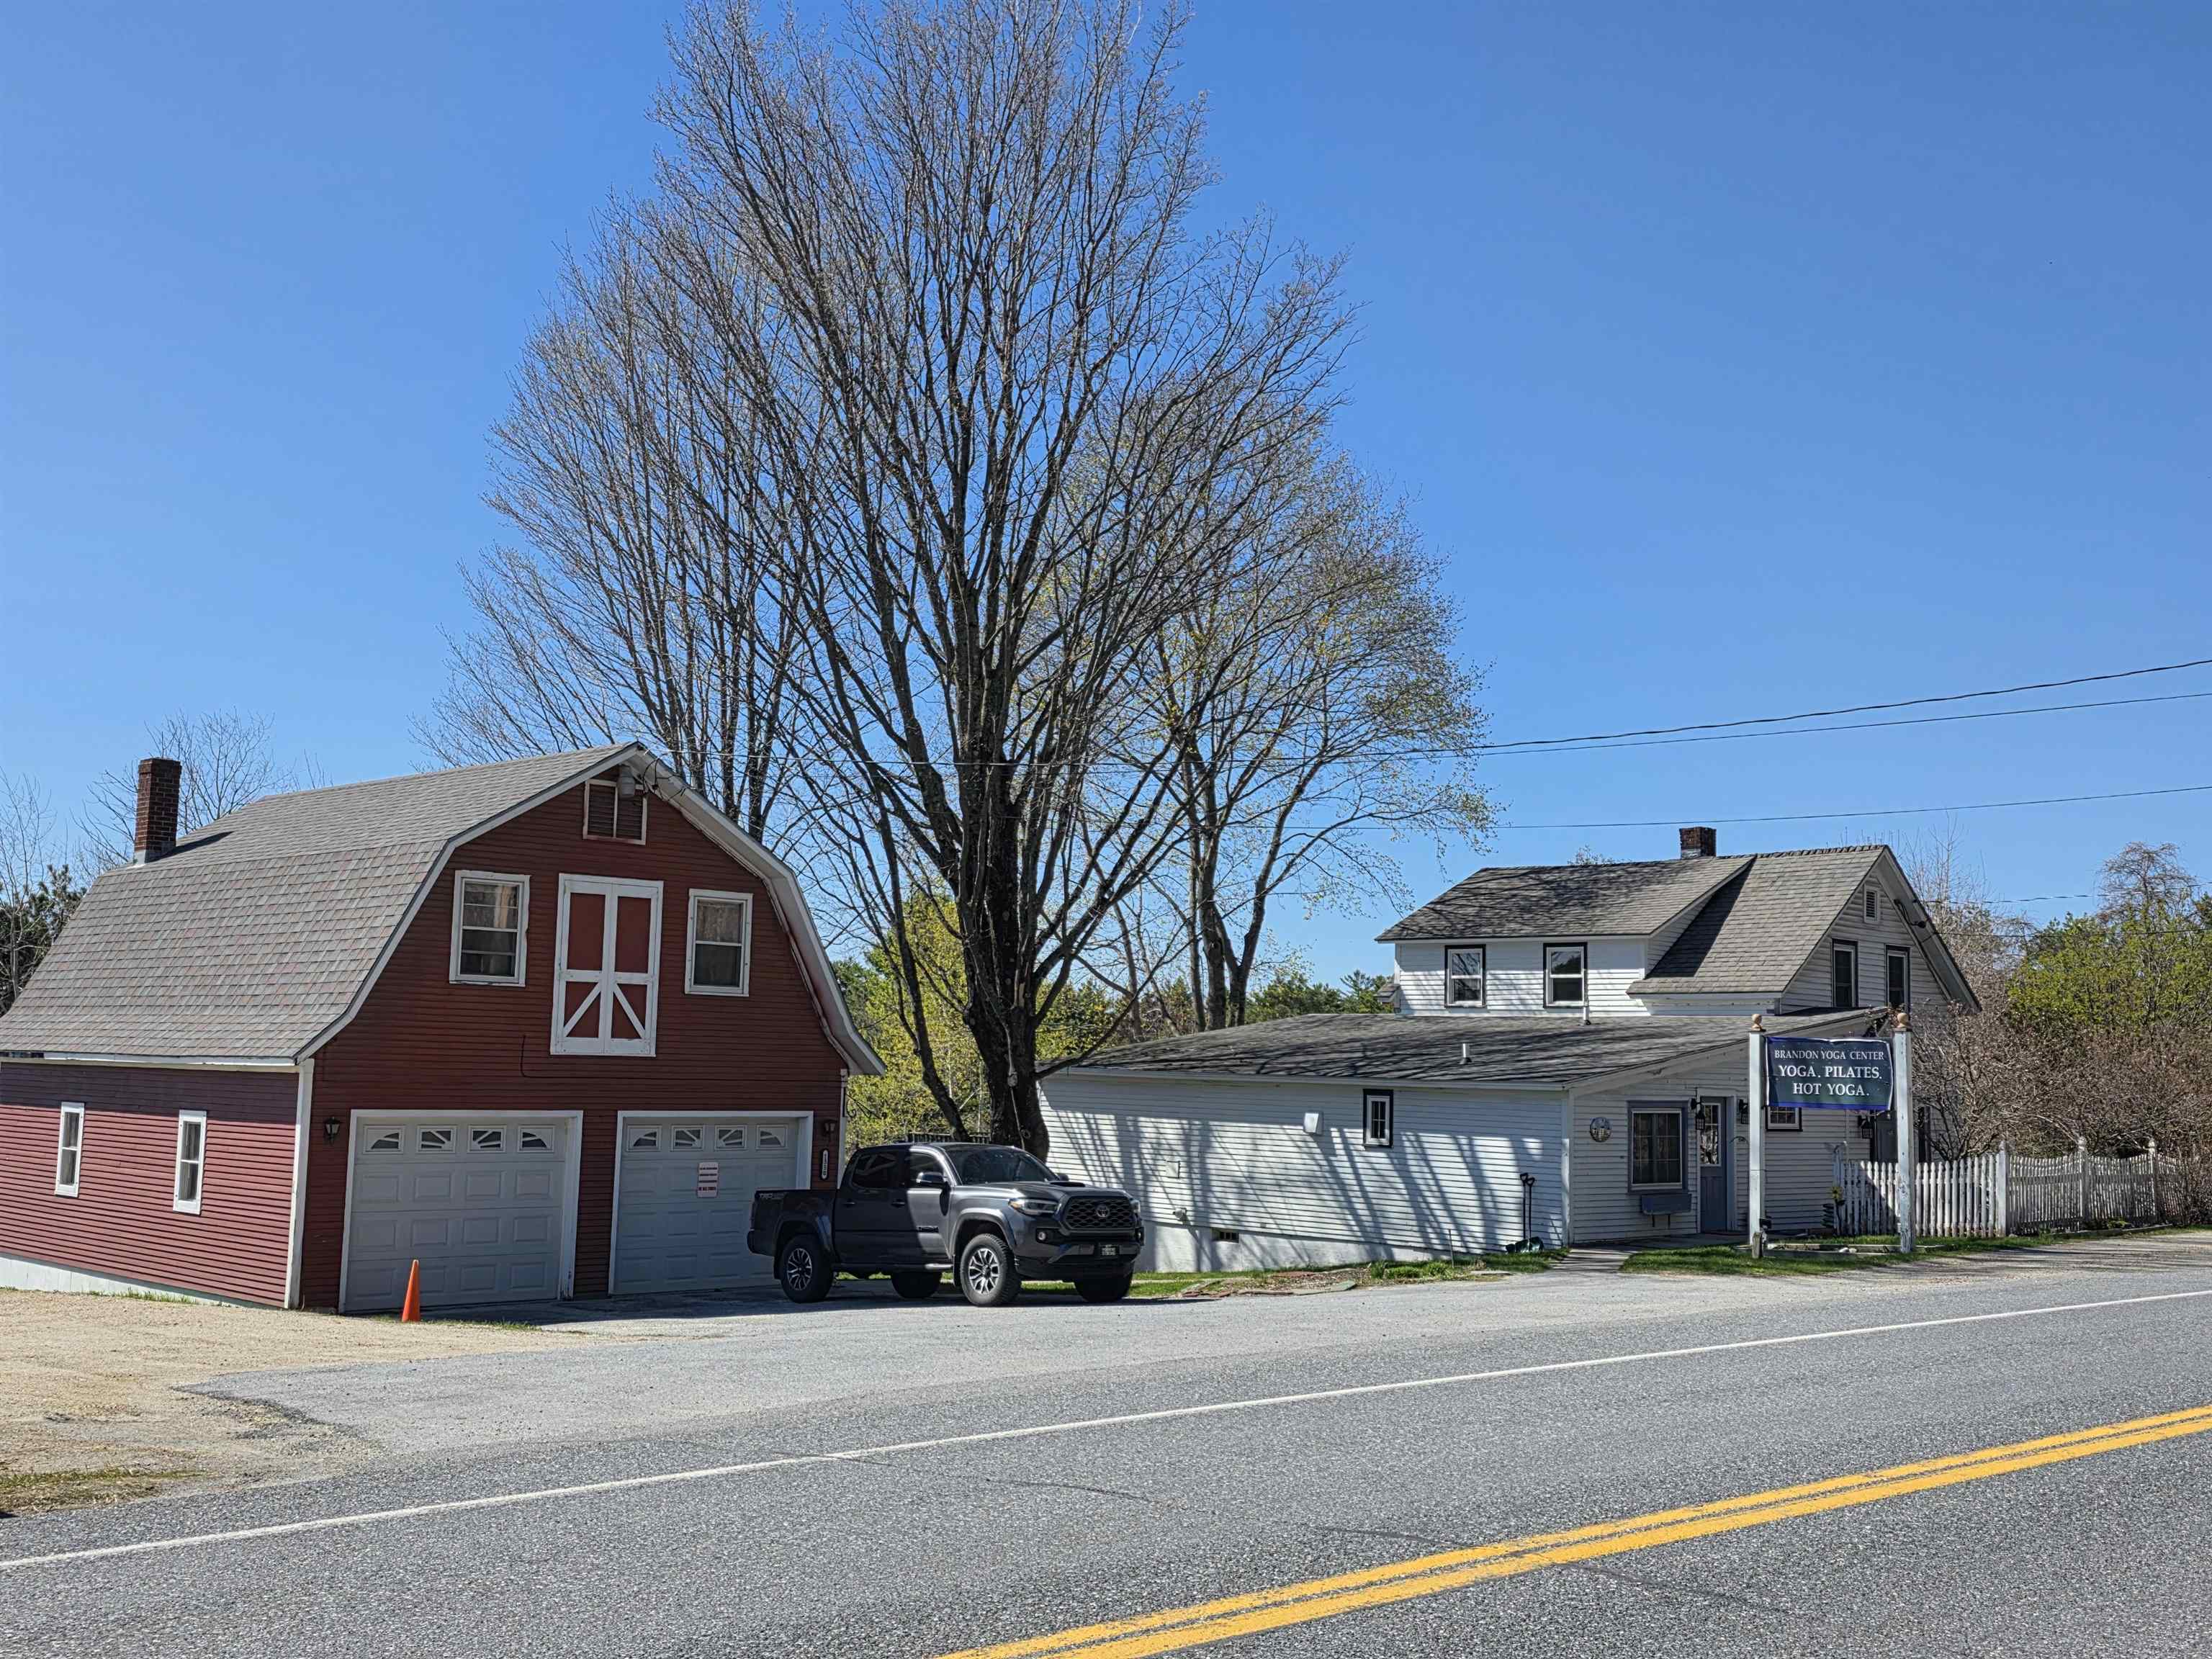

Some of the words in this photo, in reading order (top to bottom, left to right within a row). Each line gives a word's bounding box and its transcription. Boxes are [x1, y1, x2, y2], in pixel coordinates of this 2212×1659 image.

[1775, 1050, 1818, 1059] BRANDON
[1821, 1051, 1846, 1060] YOGA
[1850, 1051, 1884, 1060] CENTER
[1779, 1065, 1821, 1078] YOGA.
[1825, 1066, 1882, 1079] PILATES.
[1793, 1083, 1822, 1095] HOT
[1827, 1083, 1870, 1097] YOGA.
